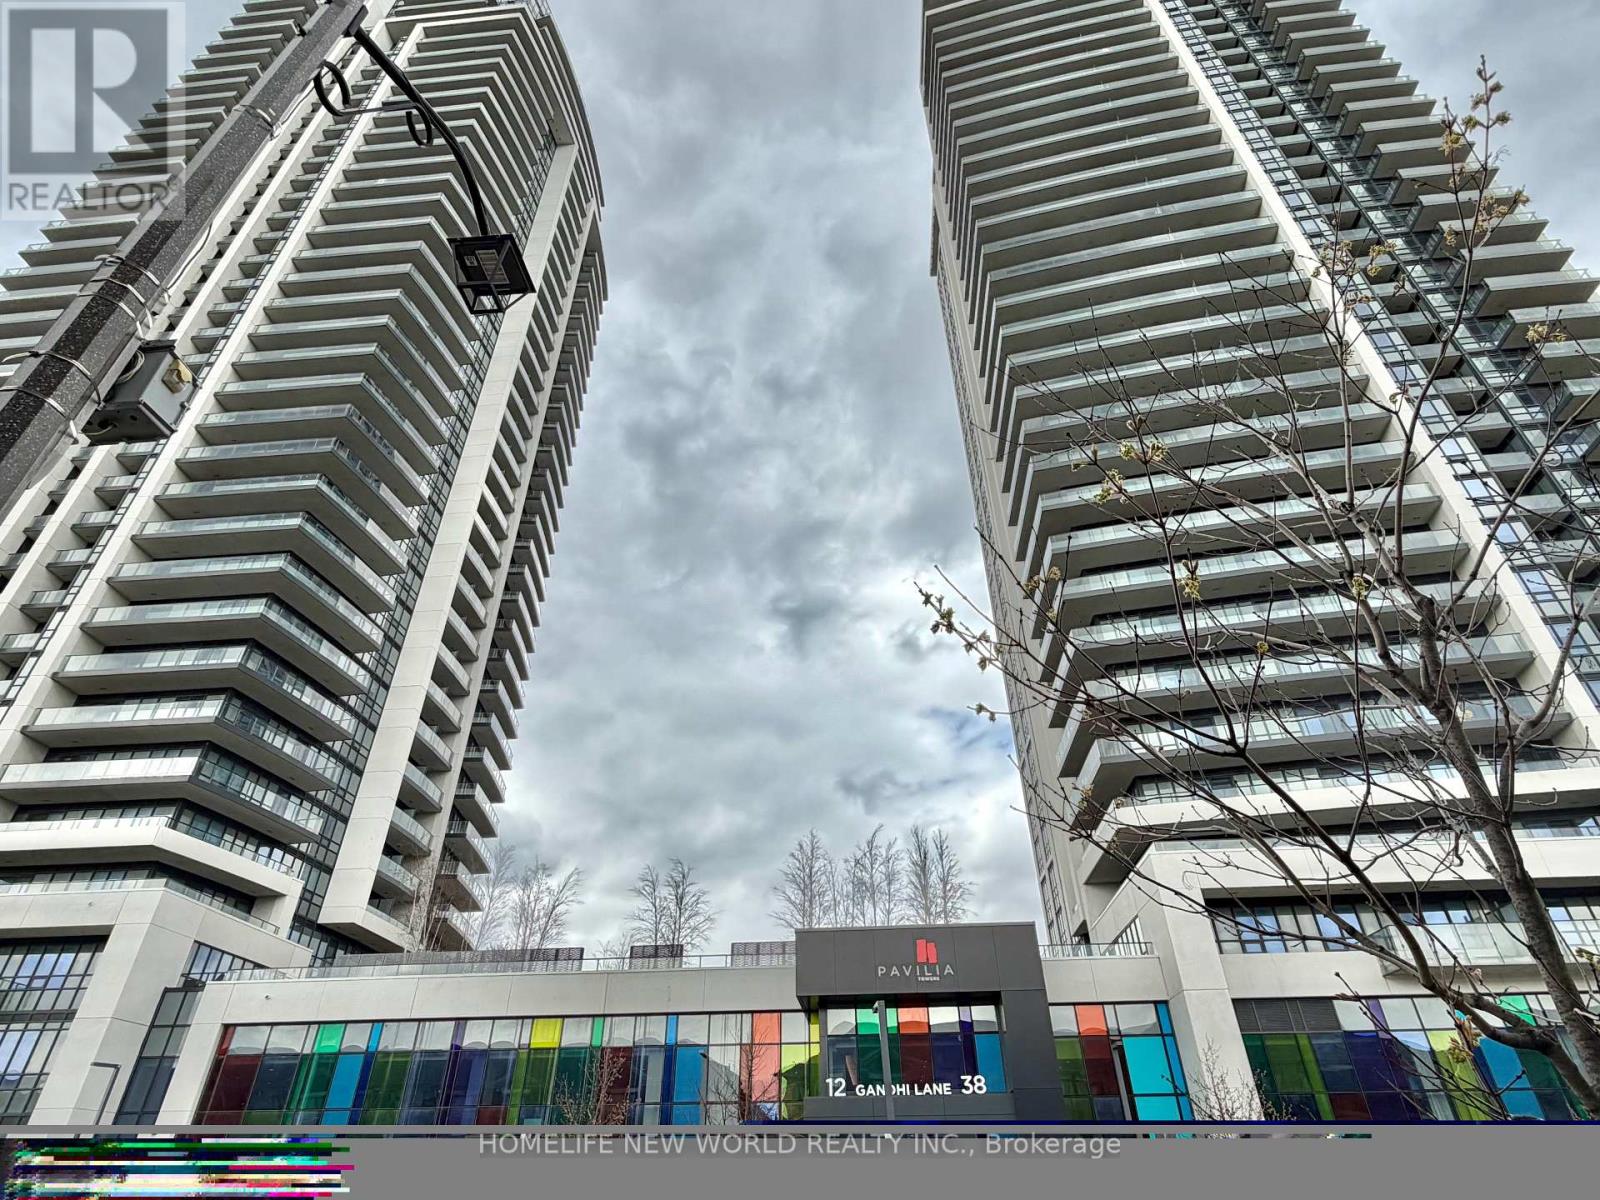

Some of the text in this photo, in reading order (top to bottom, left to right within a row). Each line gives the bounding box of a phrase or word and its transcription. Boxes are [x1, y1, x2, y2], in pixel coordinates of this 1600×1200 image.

[877, 964, 954, 977] PAVILIA
[825, 1077, 847, 1097] 12
[914, 1083, 952, 1096] LANE
[960, 1074, 987, 1095] 38
